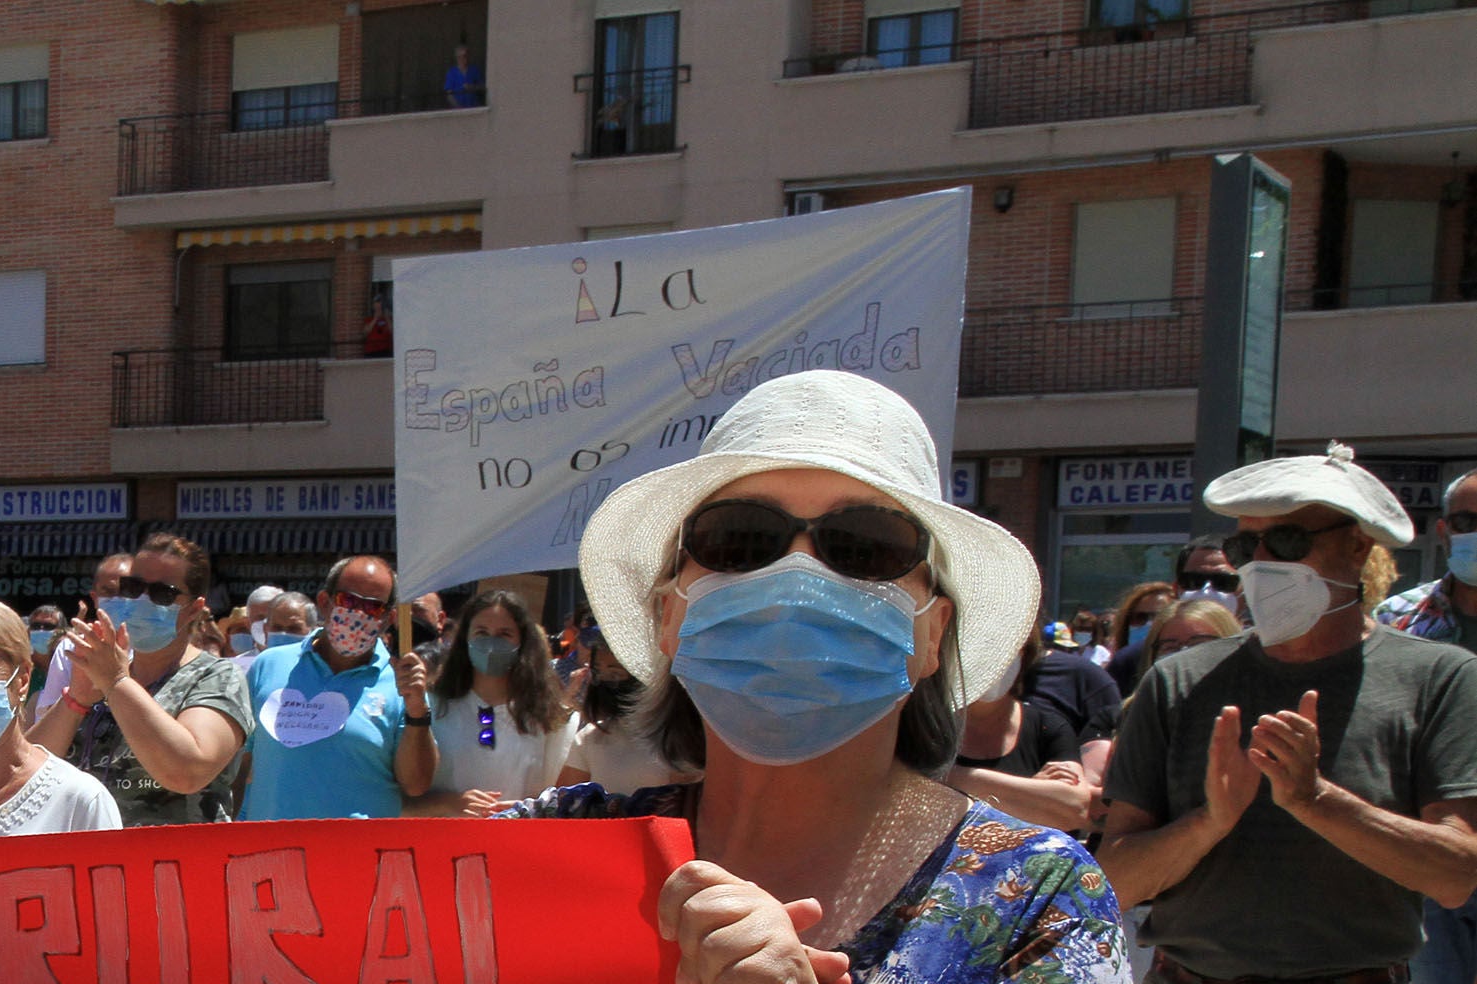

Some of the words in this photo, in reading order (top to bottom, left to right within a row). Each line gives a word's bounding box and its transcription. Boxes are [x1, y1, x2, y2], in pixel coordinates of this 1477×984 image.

[403, 348, 607, 448] España
[671, 302, 921, 400] Vaciada
[477, 456, 533, 490] no
[569, 441, 631, 472] os
[1065, 460, 1194, 482] FONTANE
[180, 486, 253, 513] MUEBLES
[265, 486, 285, 512] DE
[1070, 483, 1194, 504] CALEFAC
[116, 779, 132, 790] TO
